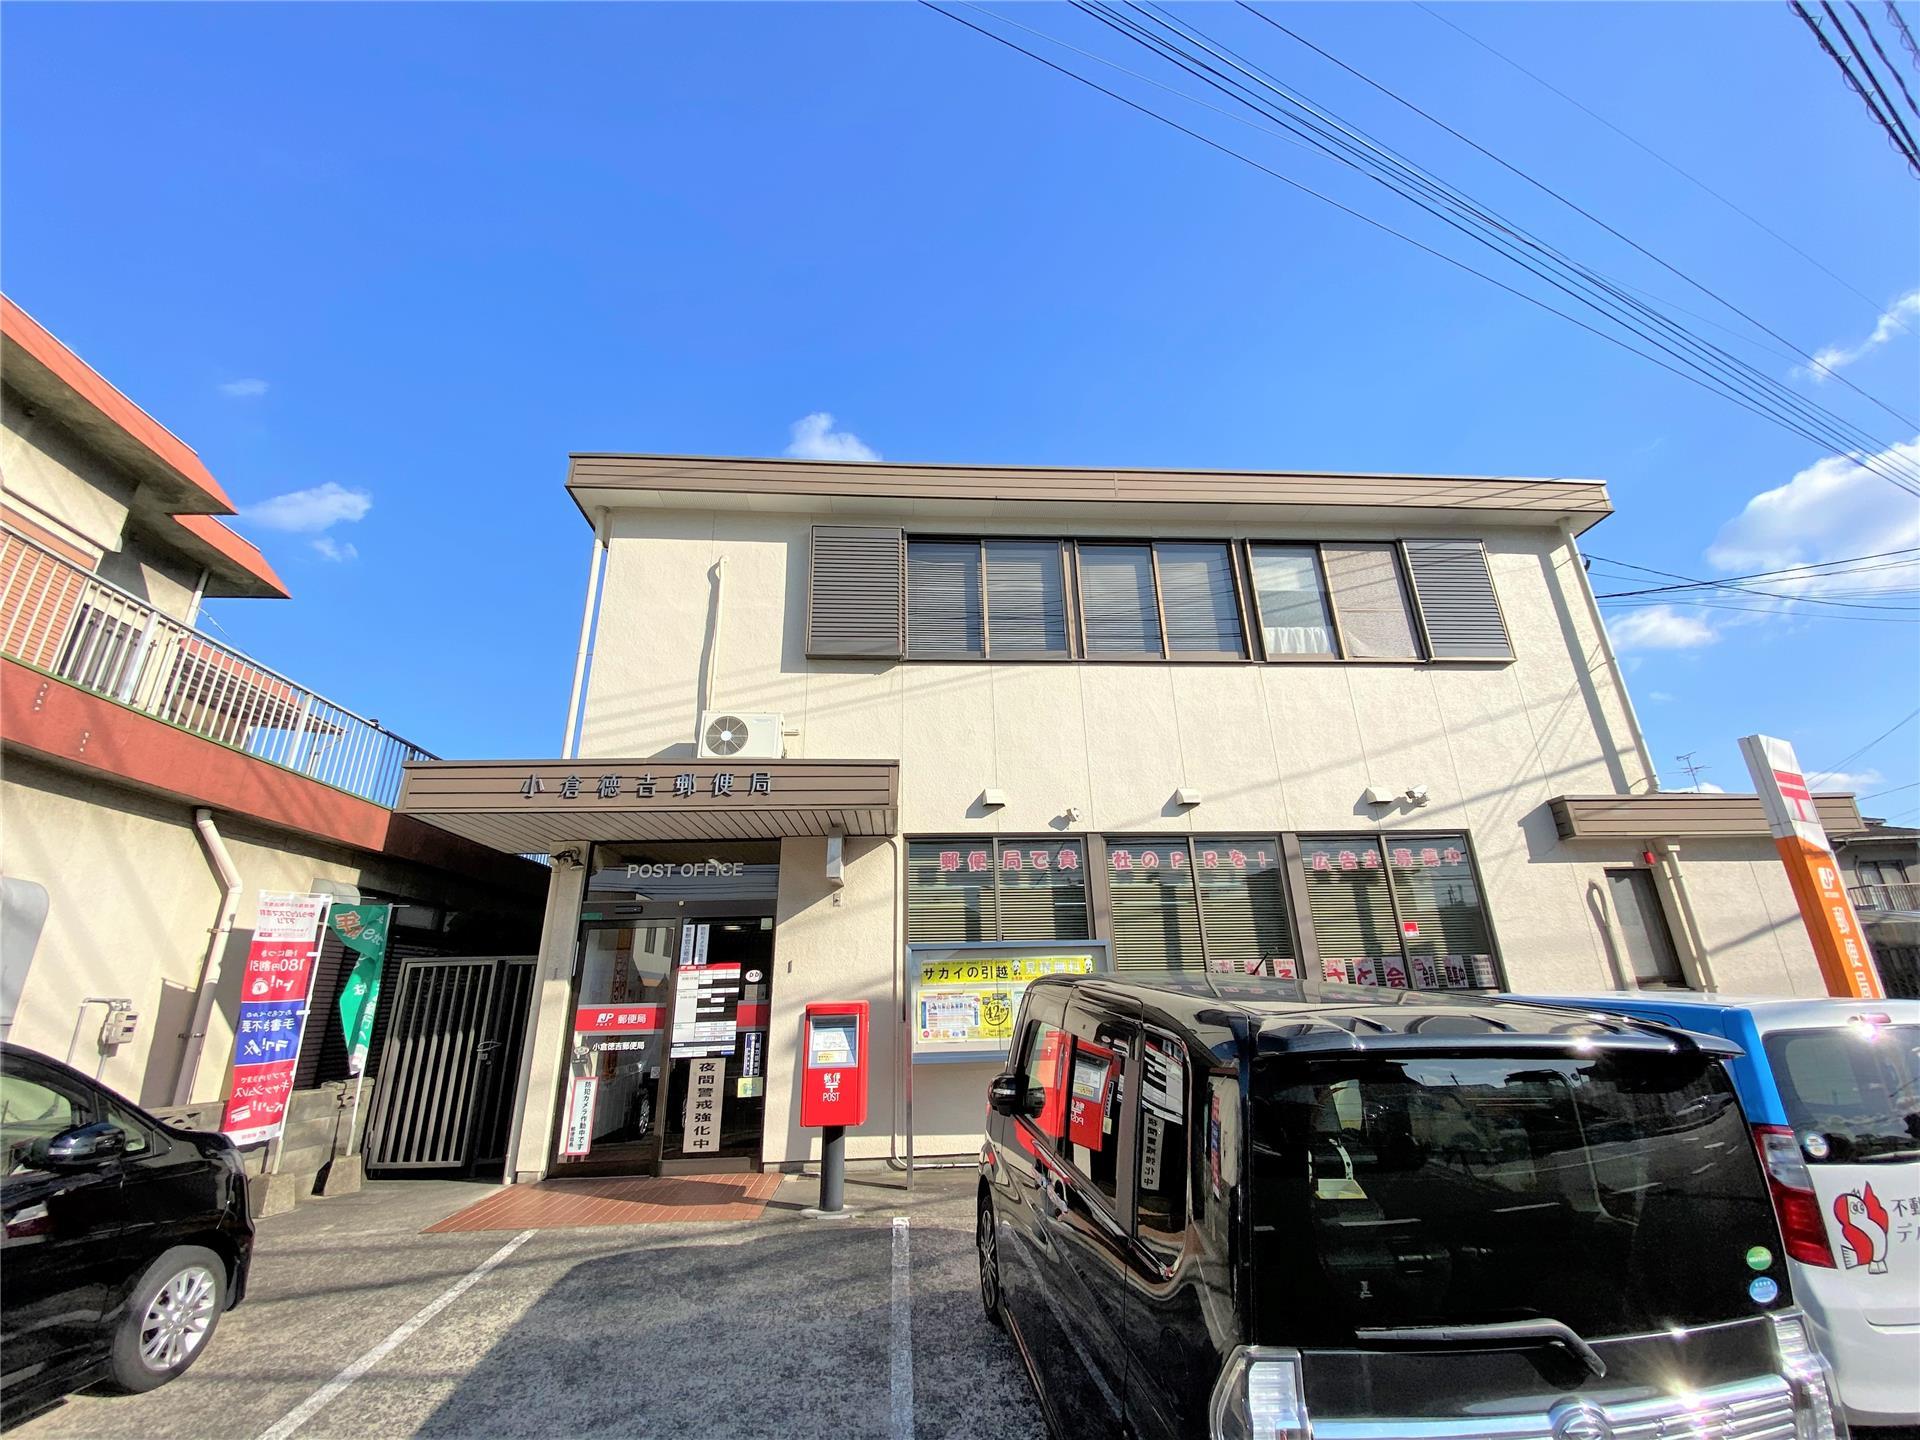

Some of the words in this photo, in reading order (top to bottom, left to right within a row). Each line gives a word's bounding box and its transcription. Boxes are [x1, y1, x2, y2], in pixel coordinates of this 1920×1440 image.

[521, 772, 772, 799] 小倉徳吉郵便局
[1311, 848, 1462, 872] 広告主募集中
[627, 863, 675, 879] POST
[680, 862, 744, 878] OFFICE
[923, 965, 1009, 981] サカイの引越
[597, 1013, 615, 1024] JP
[617, 1013, 647, 1024] 郵便局
[592, 1041, 645, 1051] 小倉徳吉郵便局
[823, 1072, 841, 1084] 郵便
[822, 1091, 841, 1102] POST
[693, 1062, 716, 1149] 夜間警戒強化中
[577, 1080, 593, 1151] 防犯カメラ作動中です
